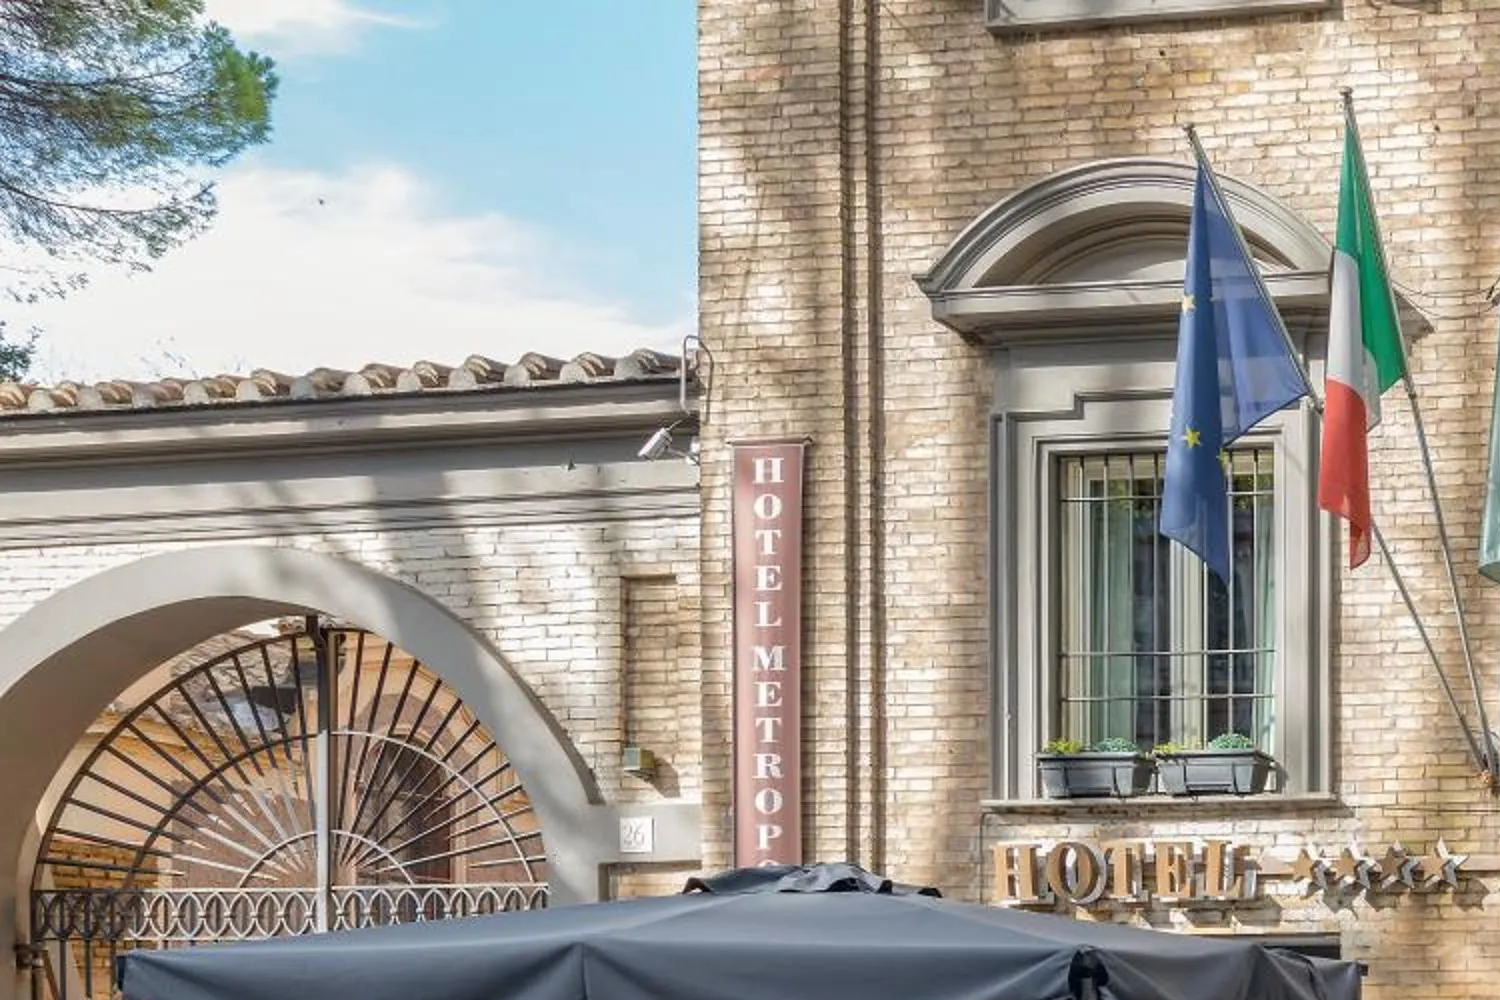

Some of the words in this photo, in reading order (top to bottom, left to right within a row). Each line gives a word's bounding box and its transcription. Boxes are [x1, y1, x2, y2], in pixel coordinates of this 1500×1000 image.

[751, 457, 785, 628] HOTEL
[751, 645, 786, 867] METROP
[623, 822, 646, 846] 26
[989, 837, 1262, 904] HOTEL
